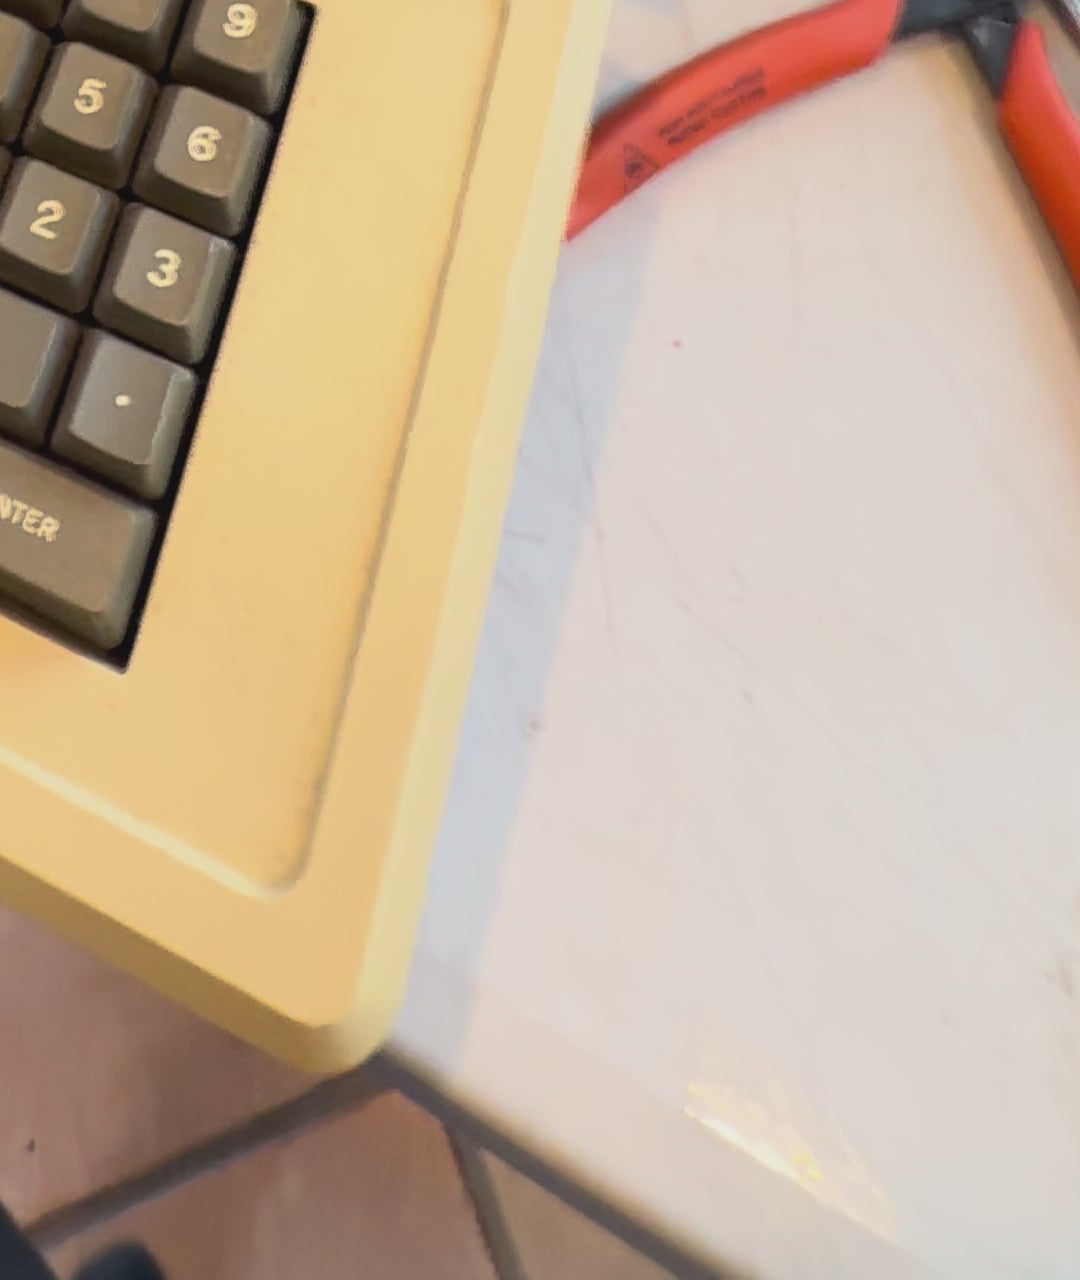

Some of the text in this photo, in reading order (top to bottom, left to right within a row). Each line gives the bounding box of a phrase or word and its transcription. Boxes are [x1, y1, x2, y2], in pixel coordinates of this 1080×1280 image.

[222, 2, 259, 40] 9
[71, 77, 108, 116] 5
[186, 125, 224, 164] 6
[29, 199, 67, 239] 2
[144, 248, 181, 288] 3
